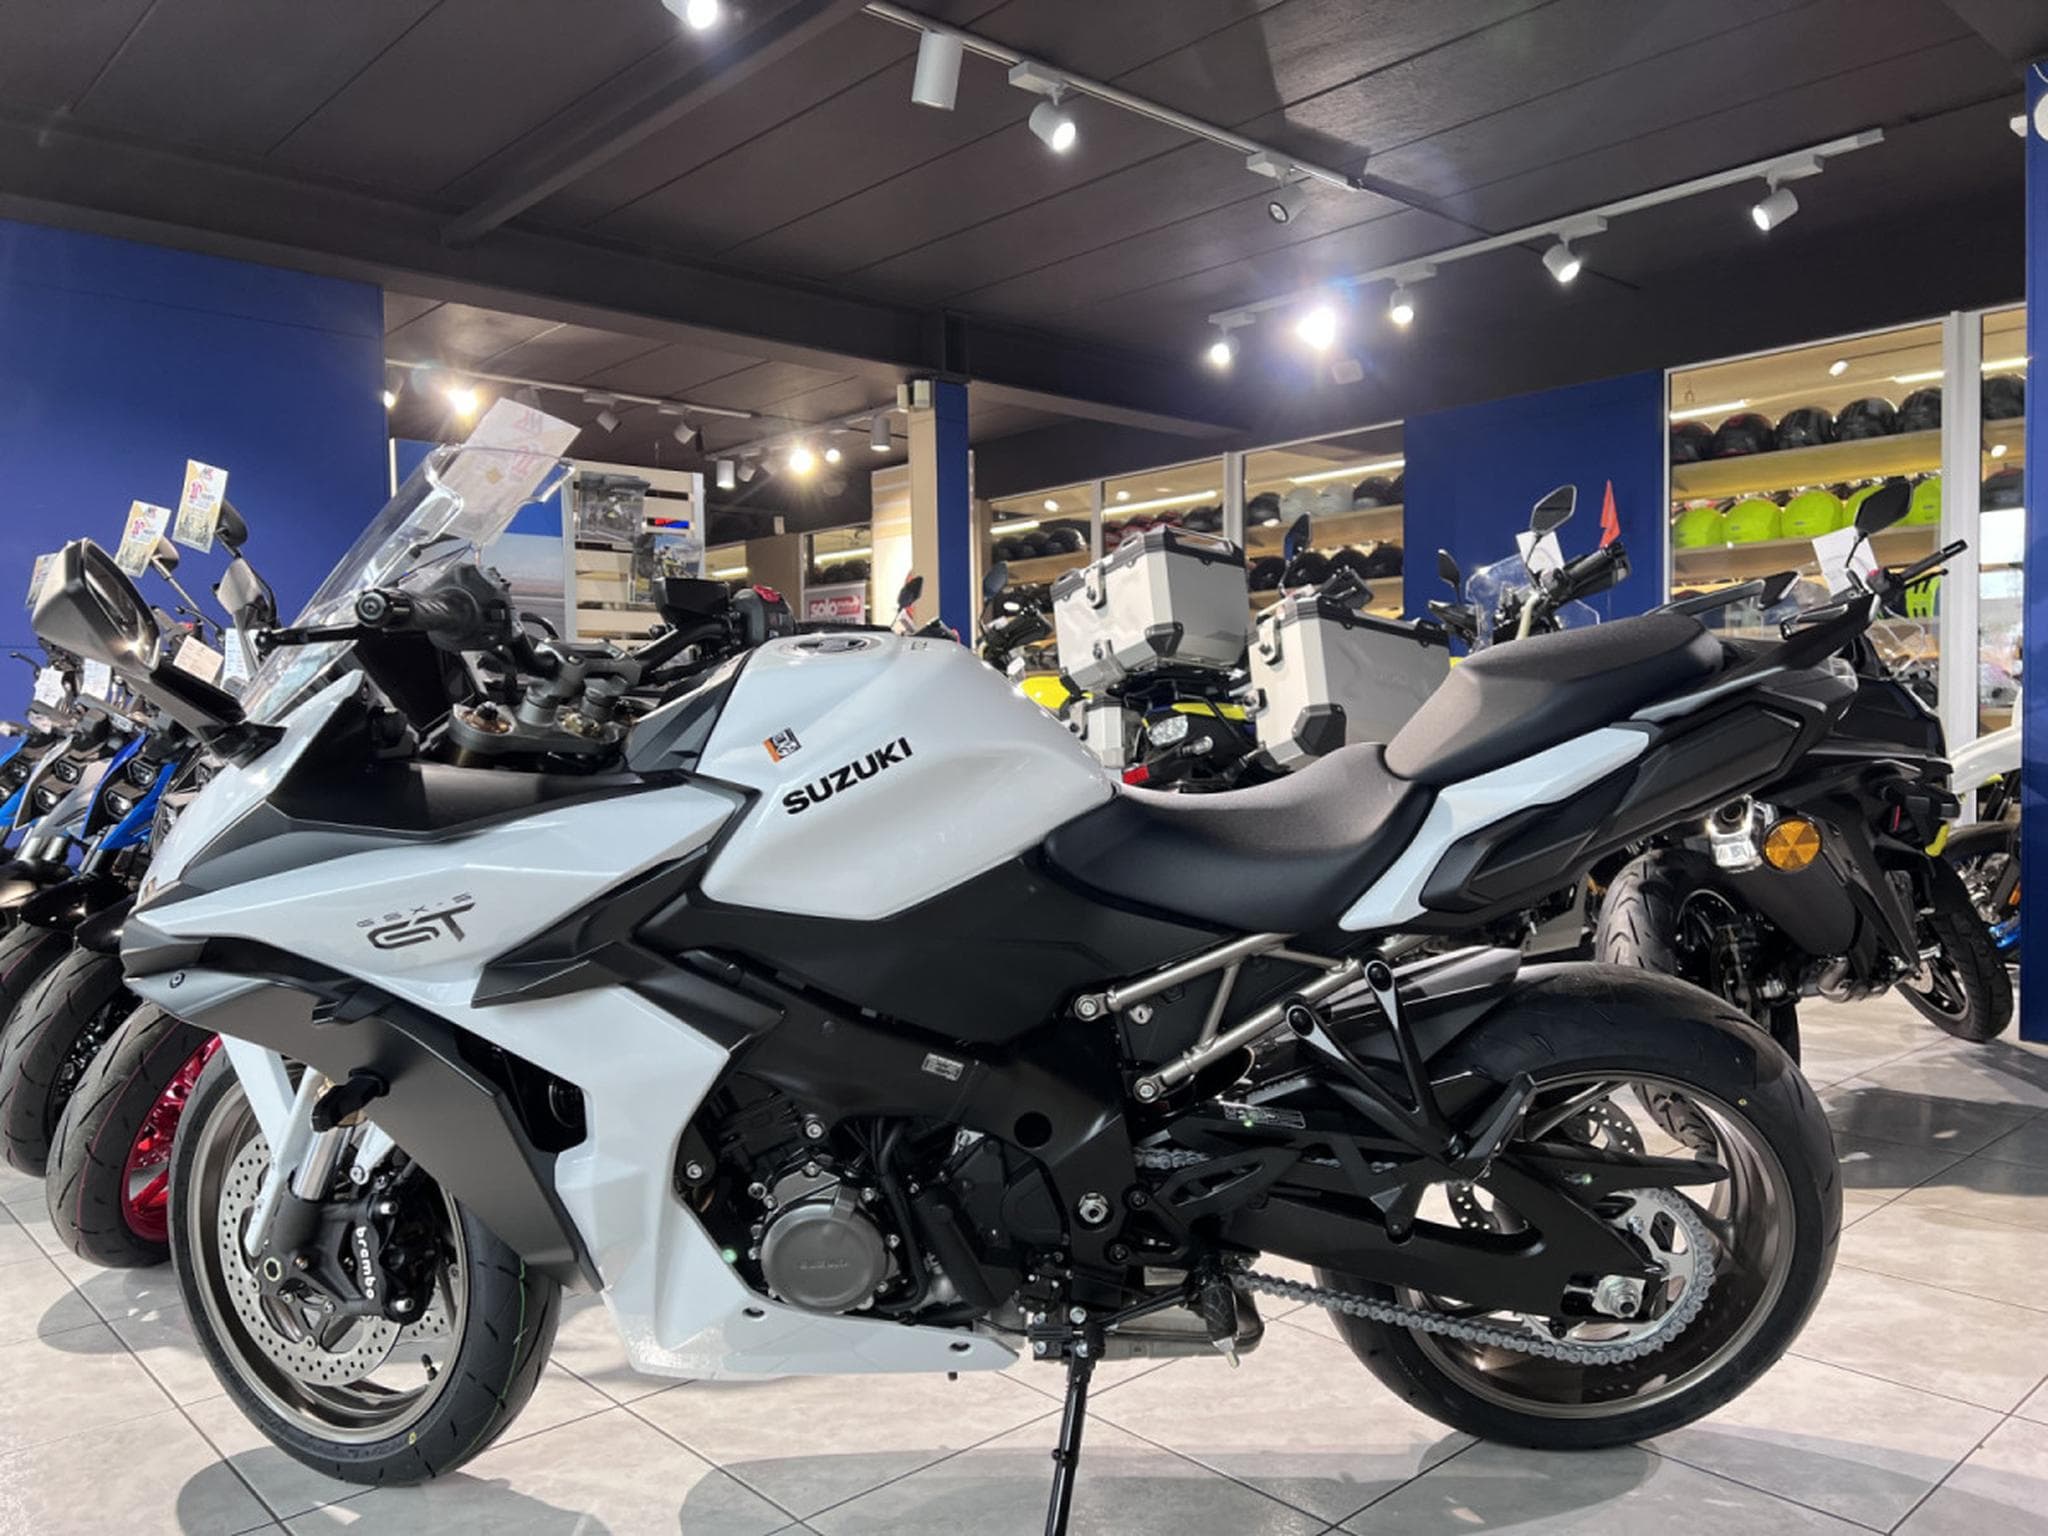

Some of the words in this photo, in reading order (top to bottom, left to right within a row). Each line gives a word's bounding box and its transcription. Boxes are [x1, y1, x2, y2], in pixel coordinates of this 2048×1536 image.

[810, 597, 838, 618] solo
[782, 737, 913, 814] SUZUKI
[367, 902, 475, 949] GT
